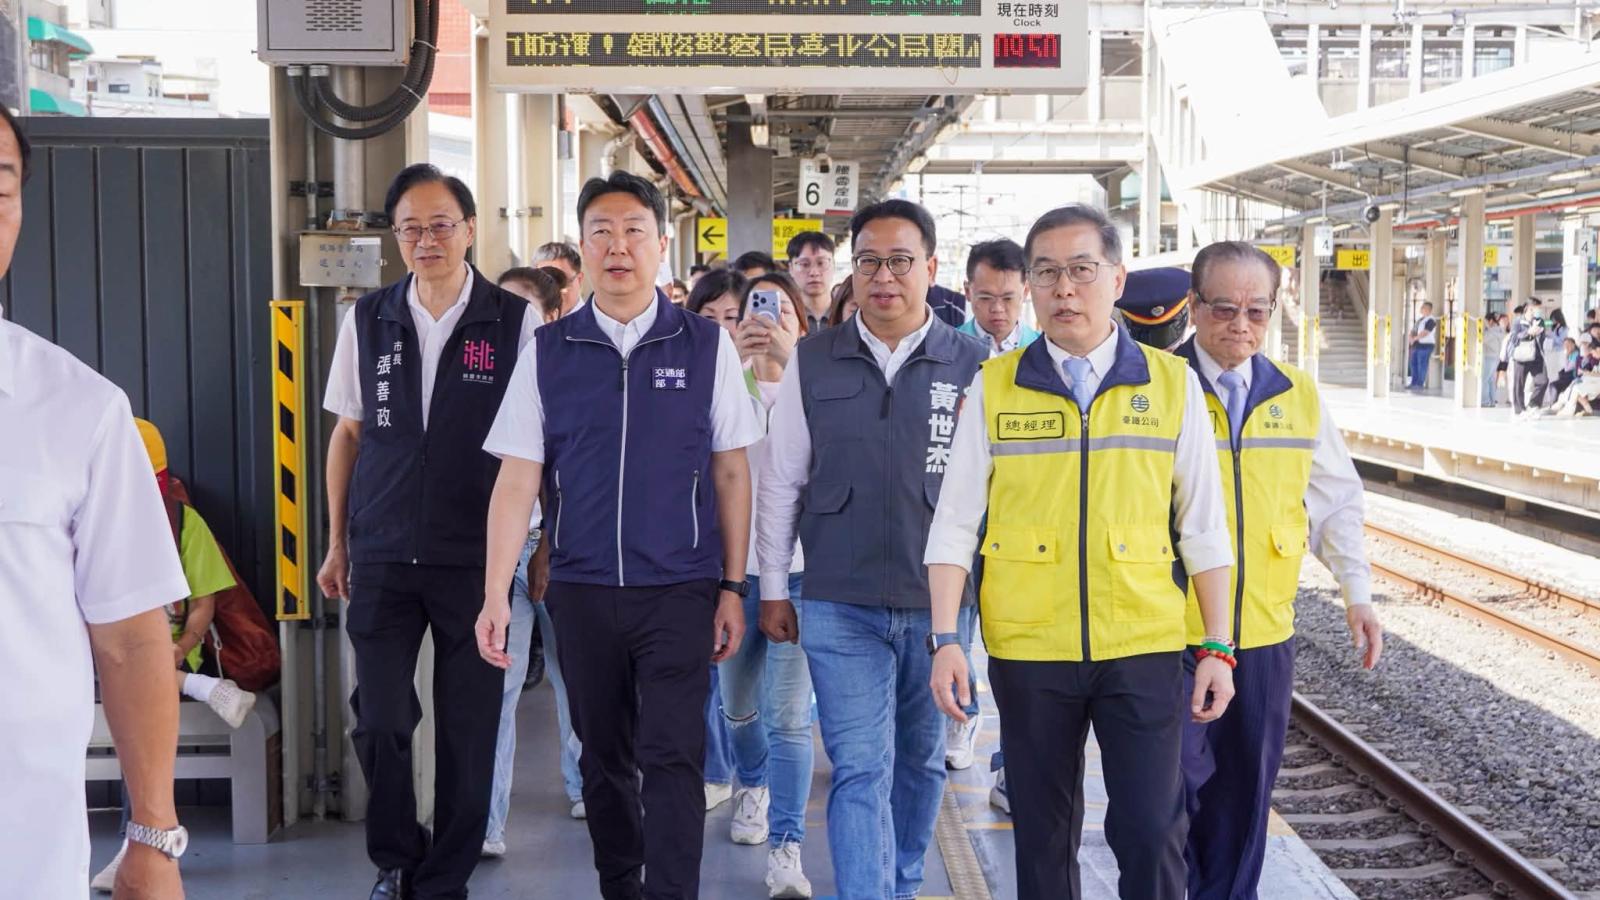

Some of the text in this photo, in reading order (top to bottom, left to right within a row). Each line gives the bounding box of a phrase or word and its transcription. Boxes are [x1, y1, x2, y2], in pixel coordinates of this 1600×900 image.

[997, 2, 1059, 18] 現在時刻
[1013, 18, 1042, 27] Clock
[806, 182, 820, 206] 6
[1322, 240, 1330, 251] 4
[1580, 241, 1589, 253] 4
[392, 341, 403, 366] 市長
[655, 368, 686, 378] 交通部
[376, 354, 392, 428] 張善政
[925, 381, 958, 474] 黃世杰
[1005, 419, 1057, 432] 總經理
[1122, 415, 1160, 428] 臺鐵公司
